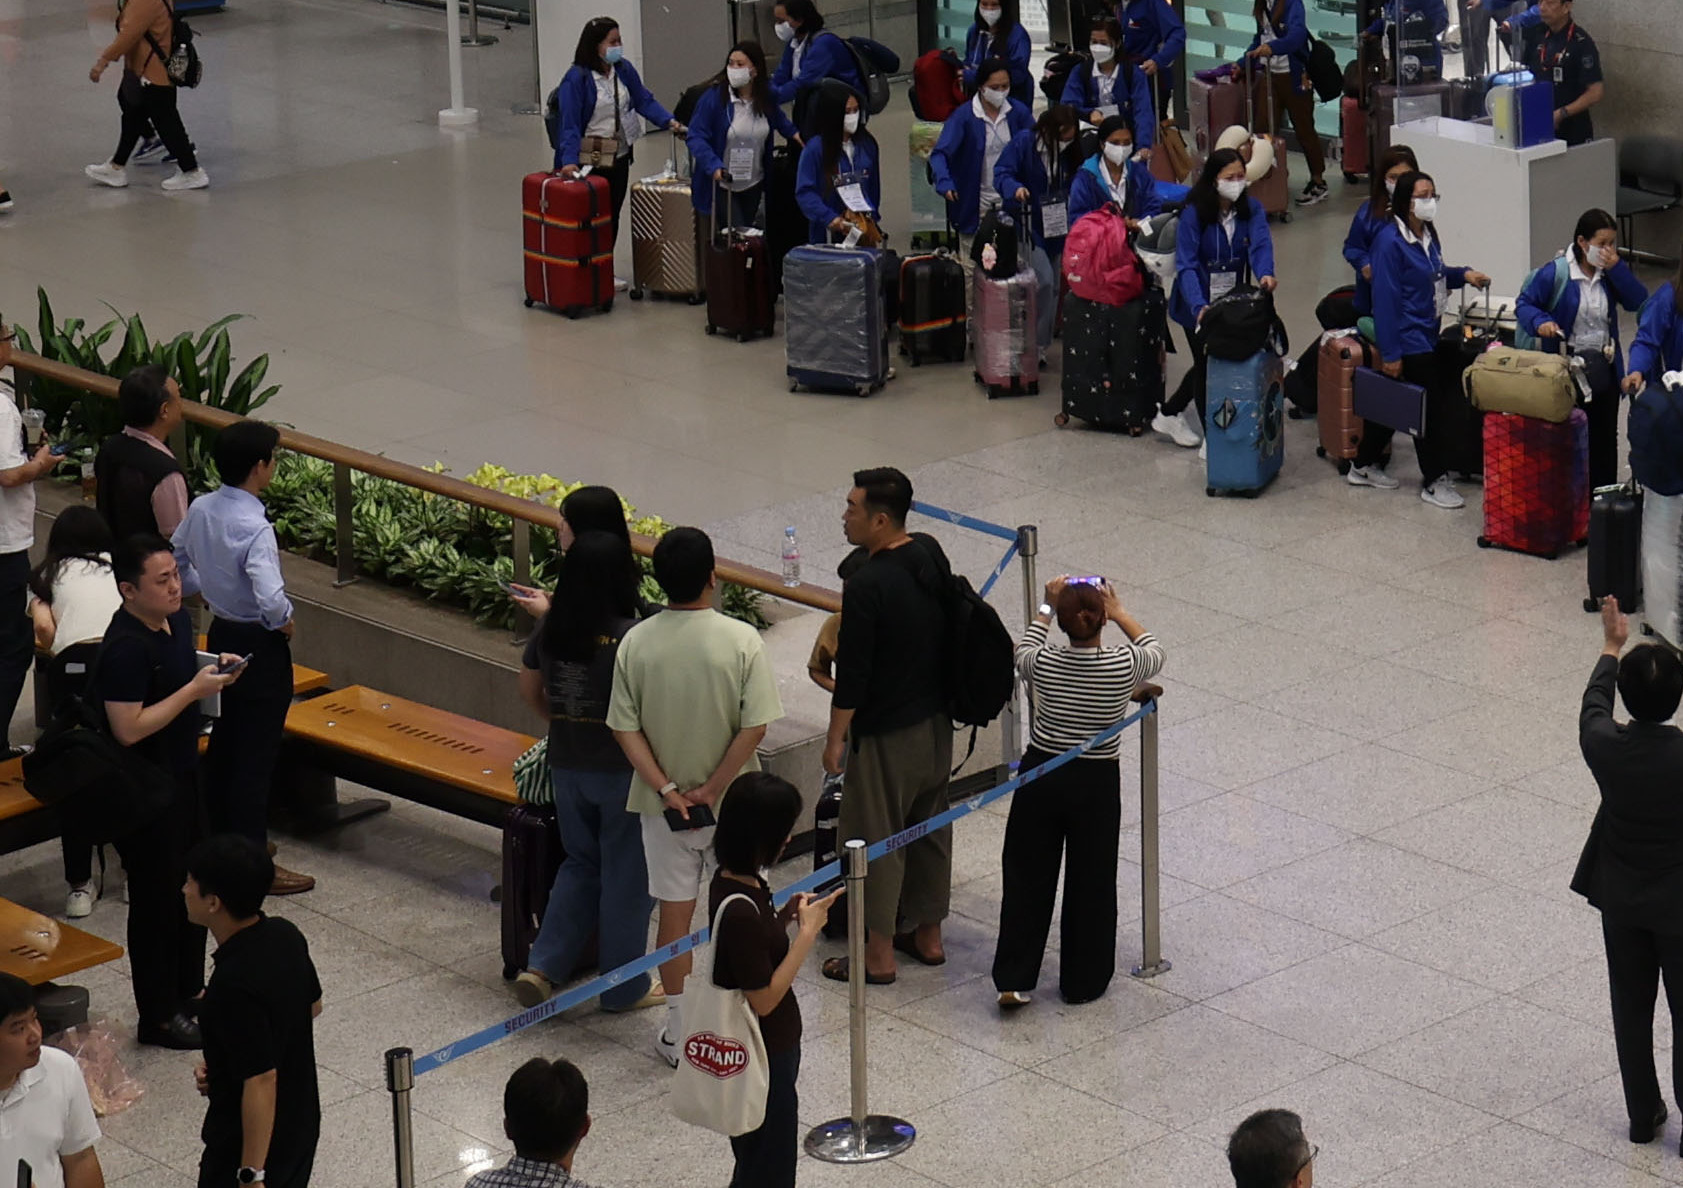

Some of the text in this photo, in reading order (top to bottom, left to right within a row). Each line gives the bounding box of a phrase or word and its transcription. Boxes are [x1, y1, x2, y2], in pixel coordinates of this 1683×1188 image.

[885, 823, 929, 852] SECURITY
[505, 1001, 557, 1033] SECURITY
[688, 1041, 745, 1065] STRAND
